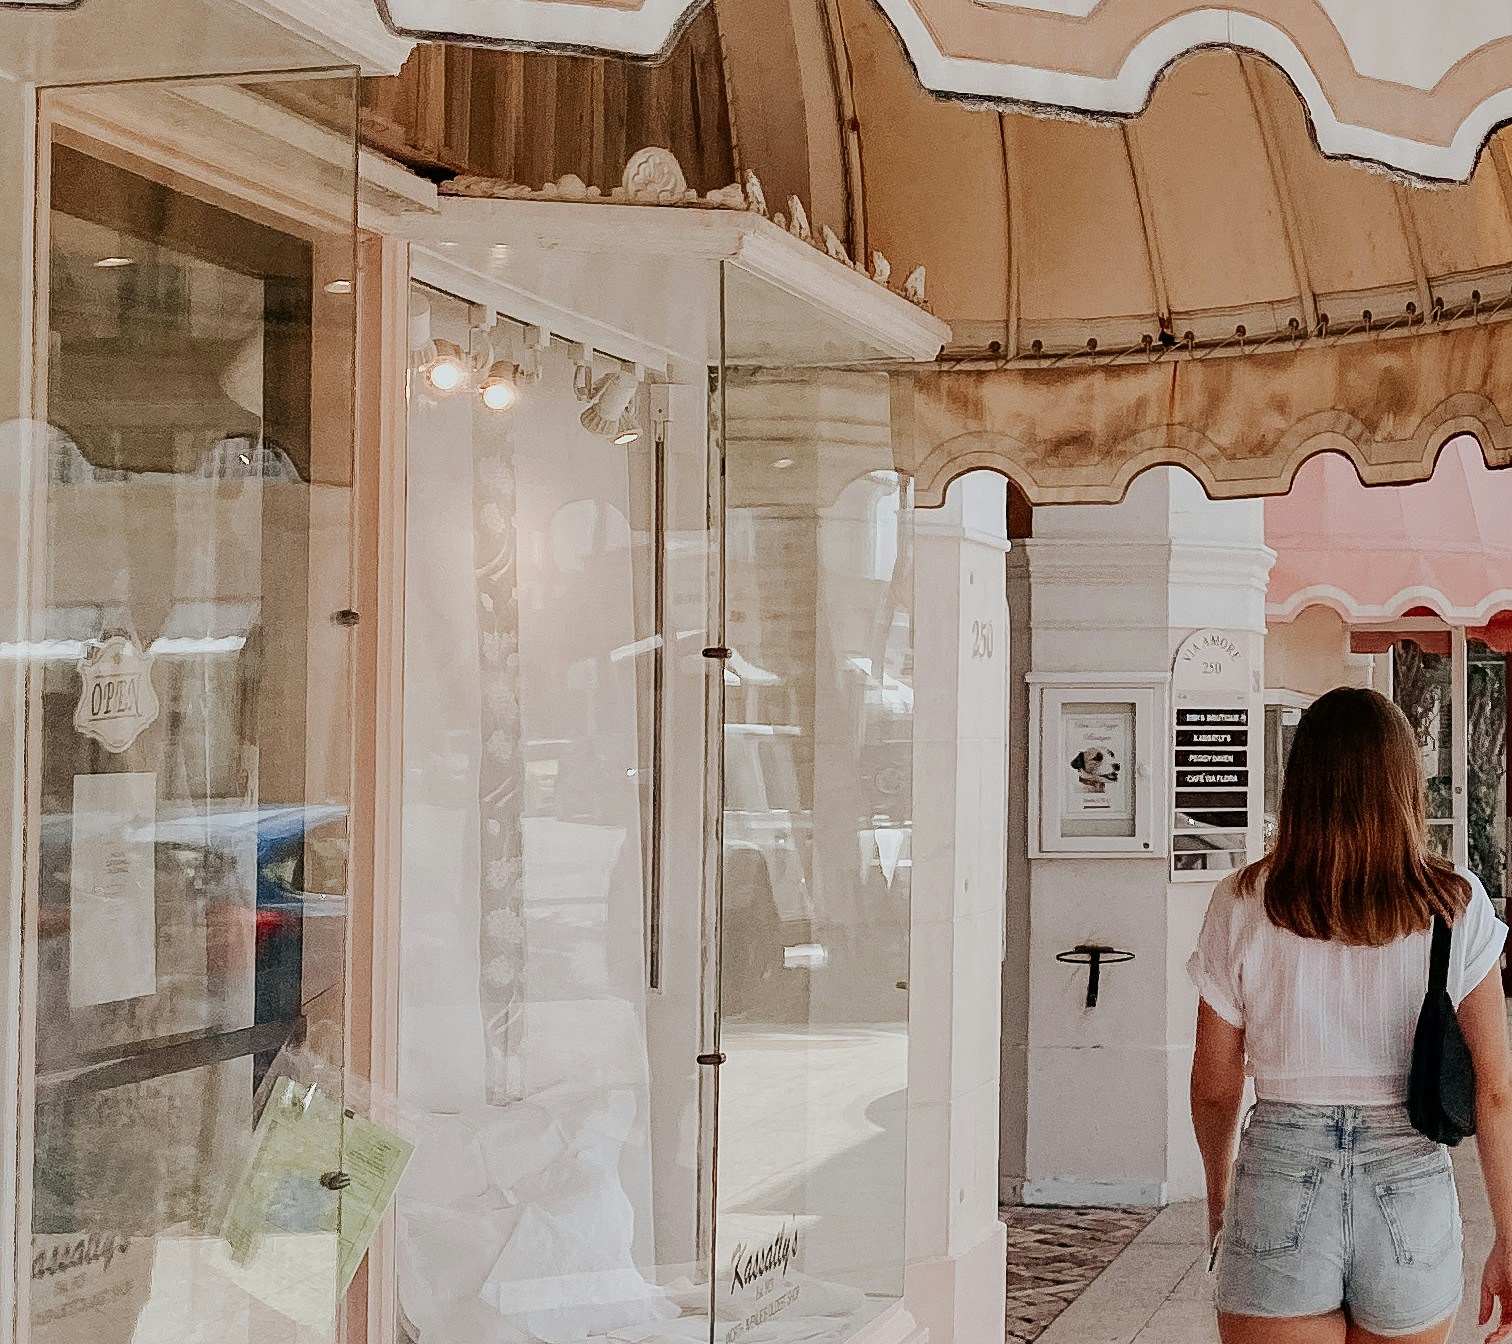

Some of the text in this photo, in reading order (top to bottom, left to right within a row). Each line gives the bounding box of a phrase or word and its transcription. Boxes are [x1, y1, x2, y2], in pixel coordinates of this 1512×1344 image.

[971, 619, 994, 659] 250
[1182, 634, 1241, 663] VIA AMORE
[1202, 661, 1222, 674] 250
[91, 677, 143, 716] OPEN
